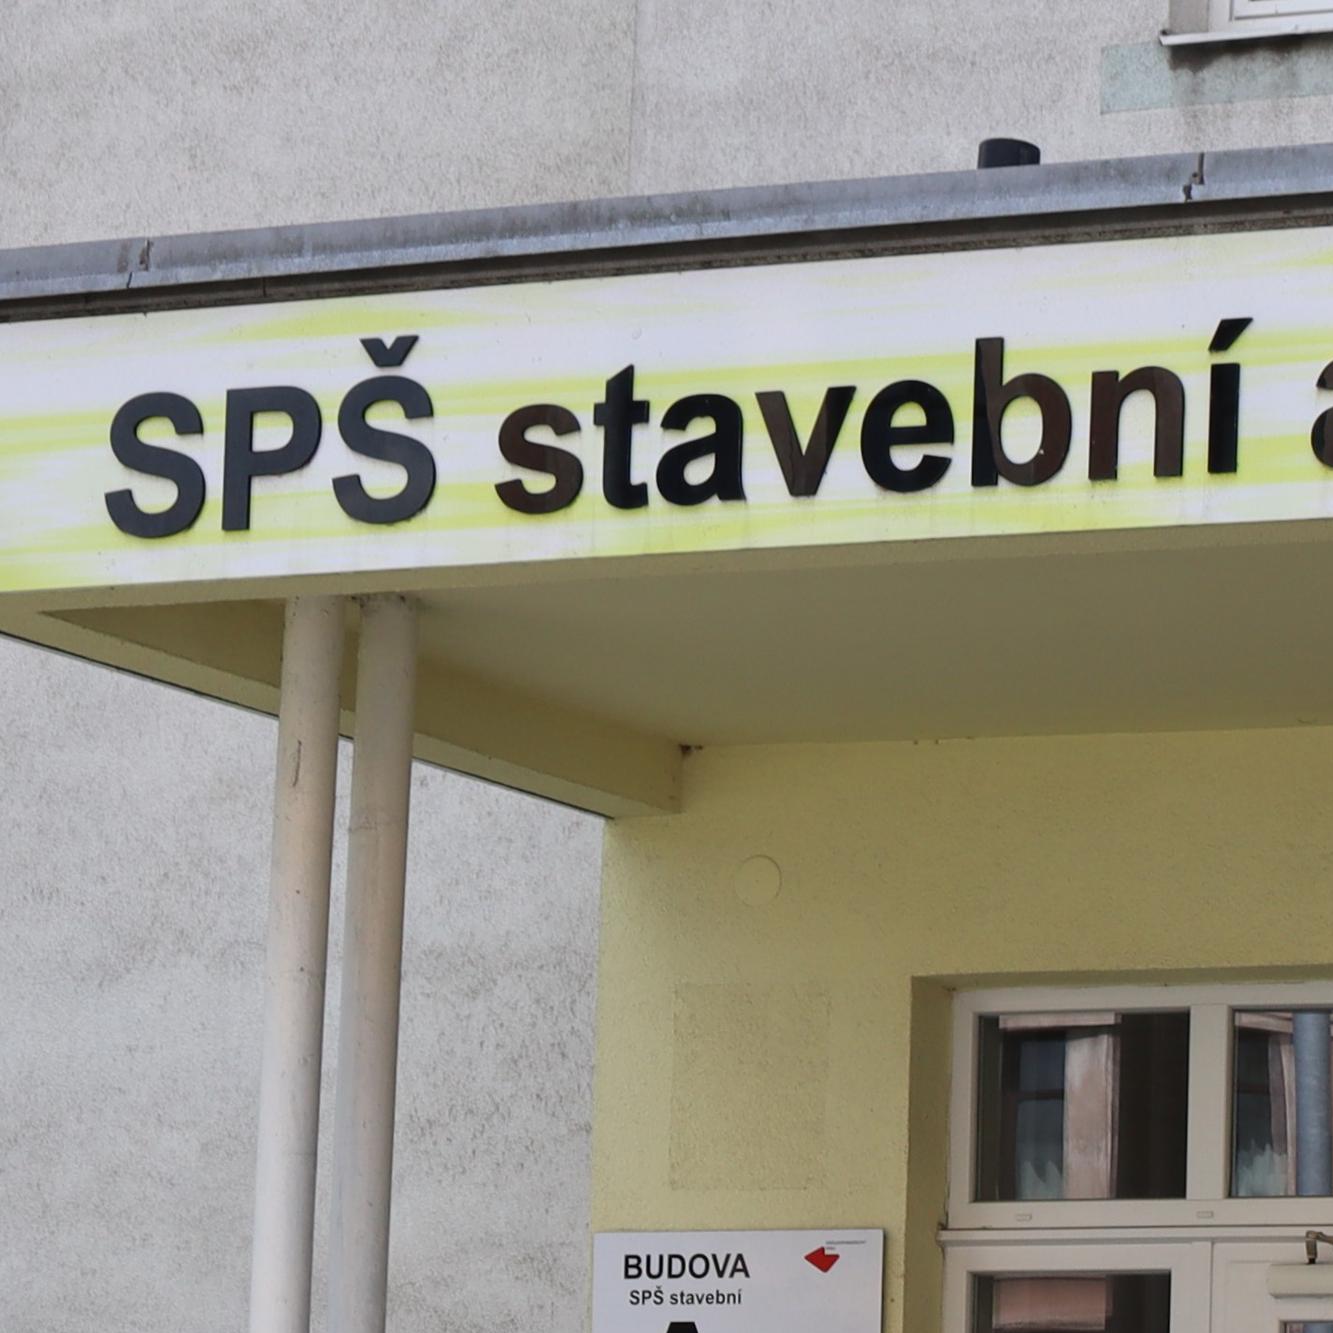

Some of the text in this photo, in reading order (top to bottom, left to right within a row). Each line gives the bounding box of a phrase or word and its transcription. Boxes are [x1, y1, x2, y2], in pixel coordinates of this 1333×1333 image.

[104, 335, 436, 538] SPŠ
[494, 317, 1254, 514] stavební
[624, 1253, 750, 1279] BUDOVA
[629, 1285, 743, 1305] SPŠ stavební
